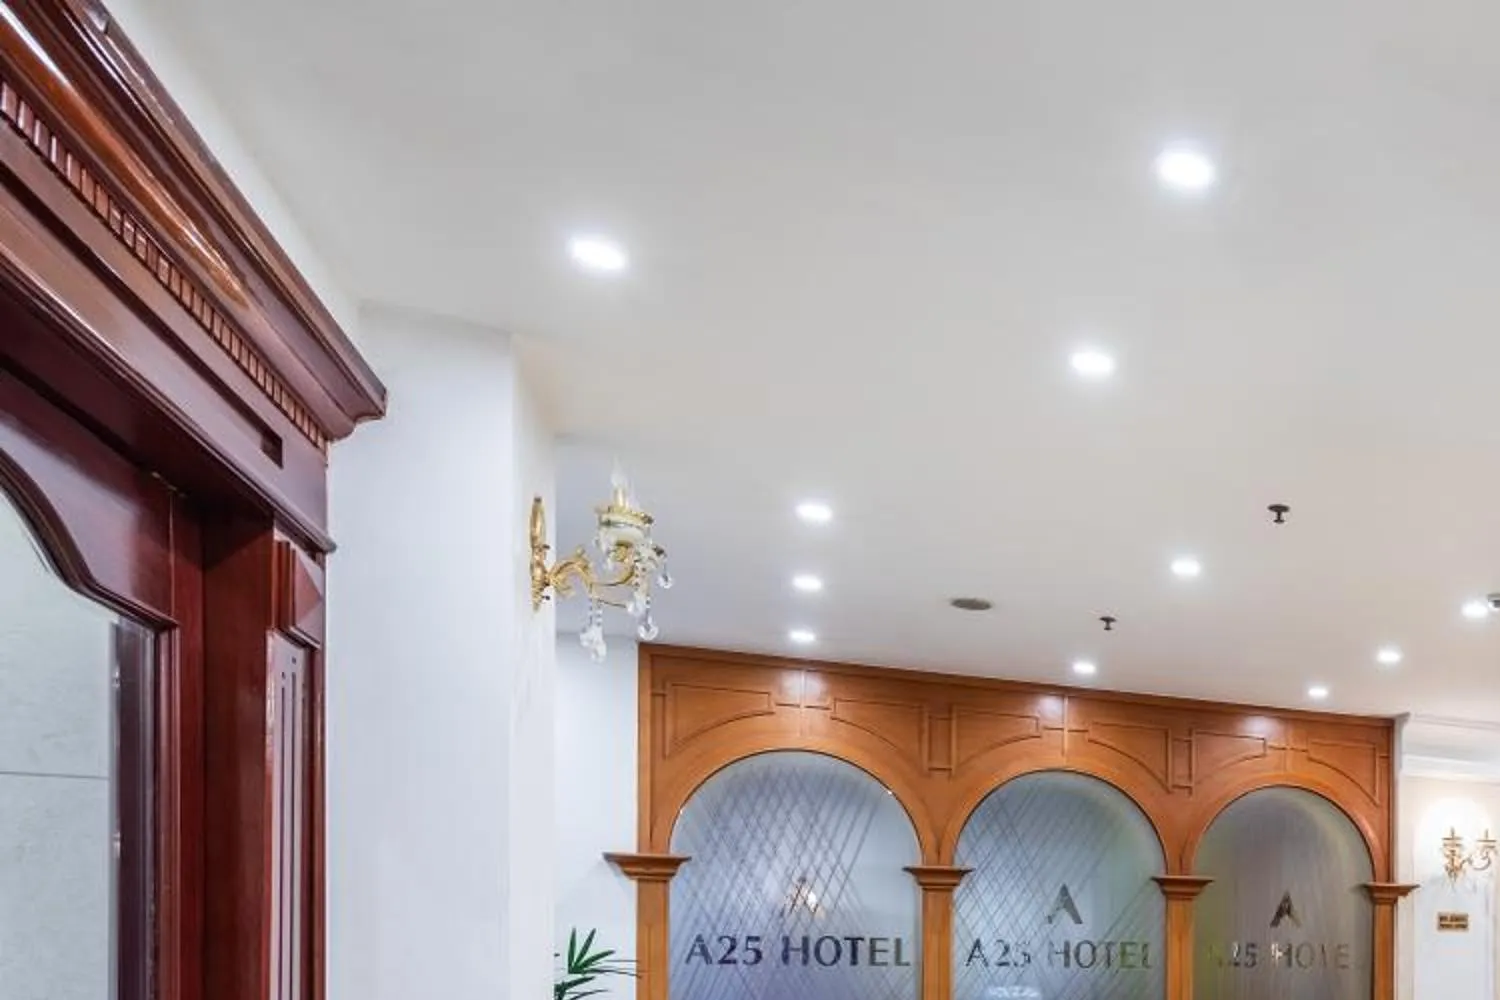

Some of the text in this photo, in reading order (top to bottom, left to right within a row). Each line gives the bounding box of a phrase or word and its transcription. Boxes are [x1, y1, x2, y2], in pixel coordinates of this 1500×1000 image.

[684, 933, 911, 967] A25 HOTEL
[965, 938, 1152, 970] A25 HOTEL
[1207, 942, 1258, 969] 25
